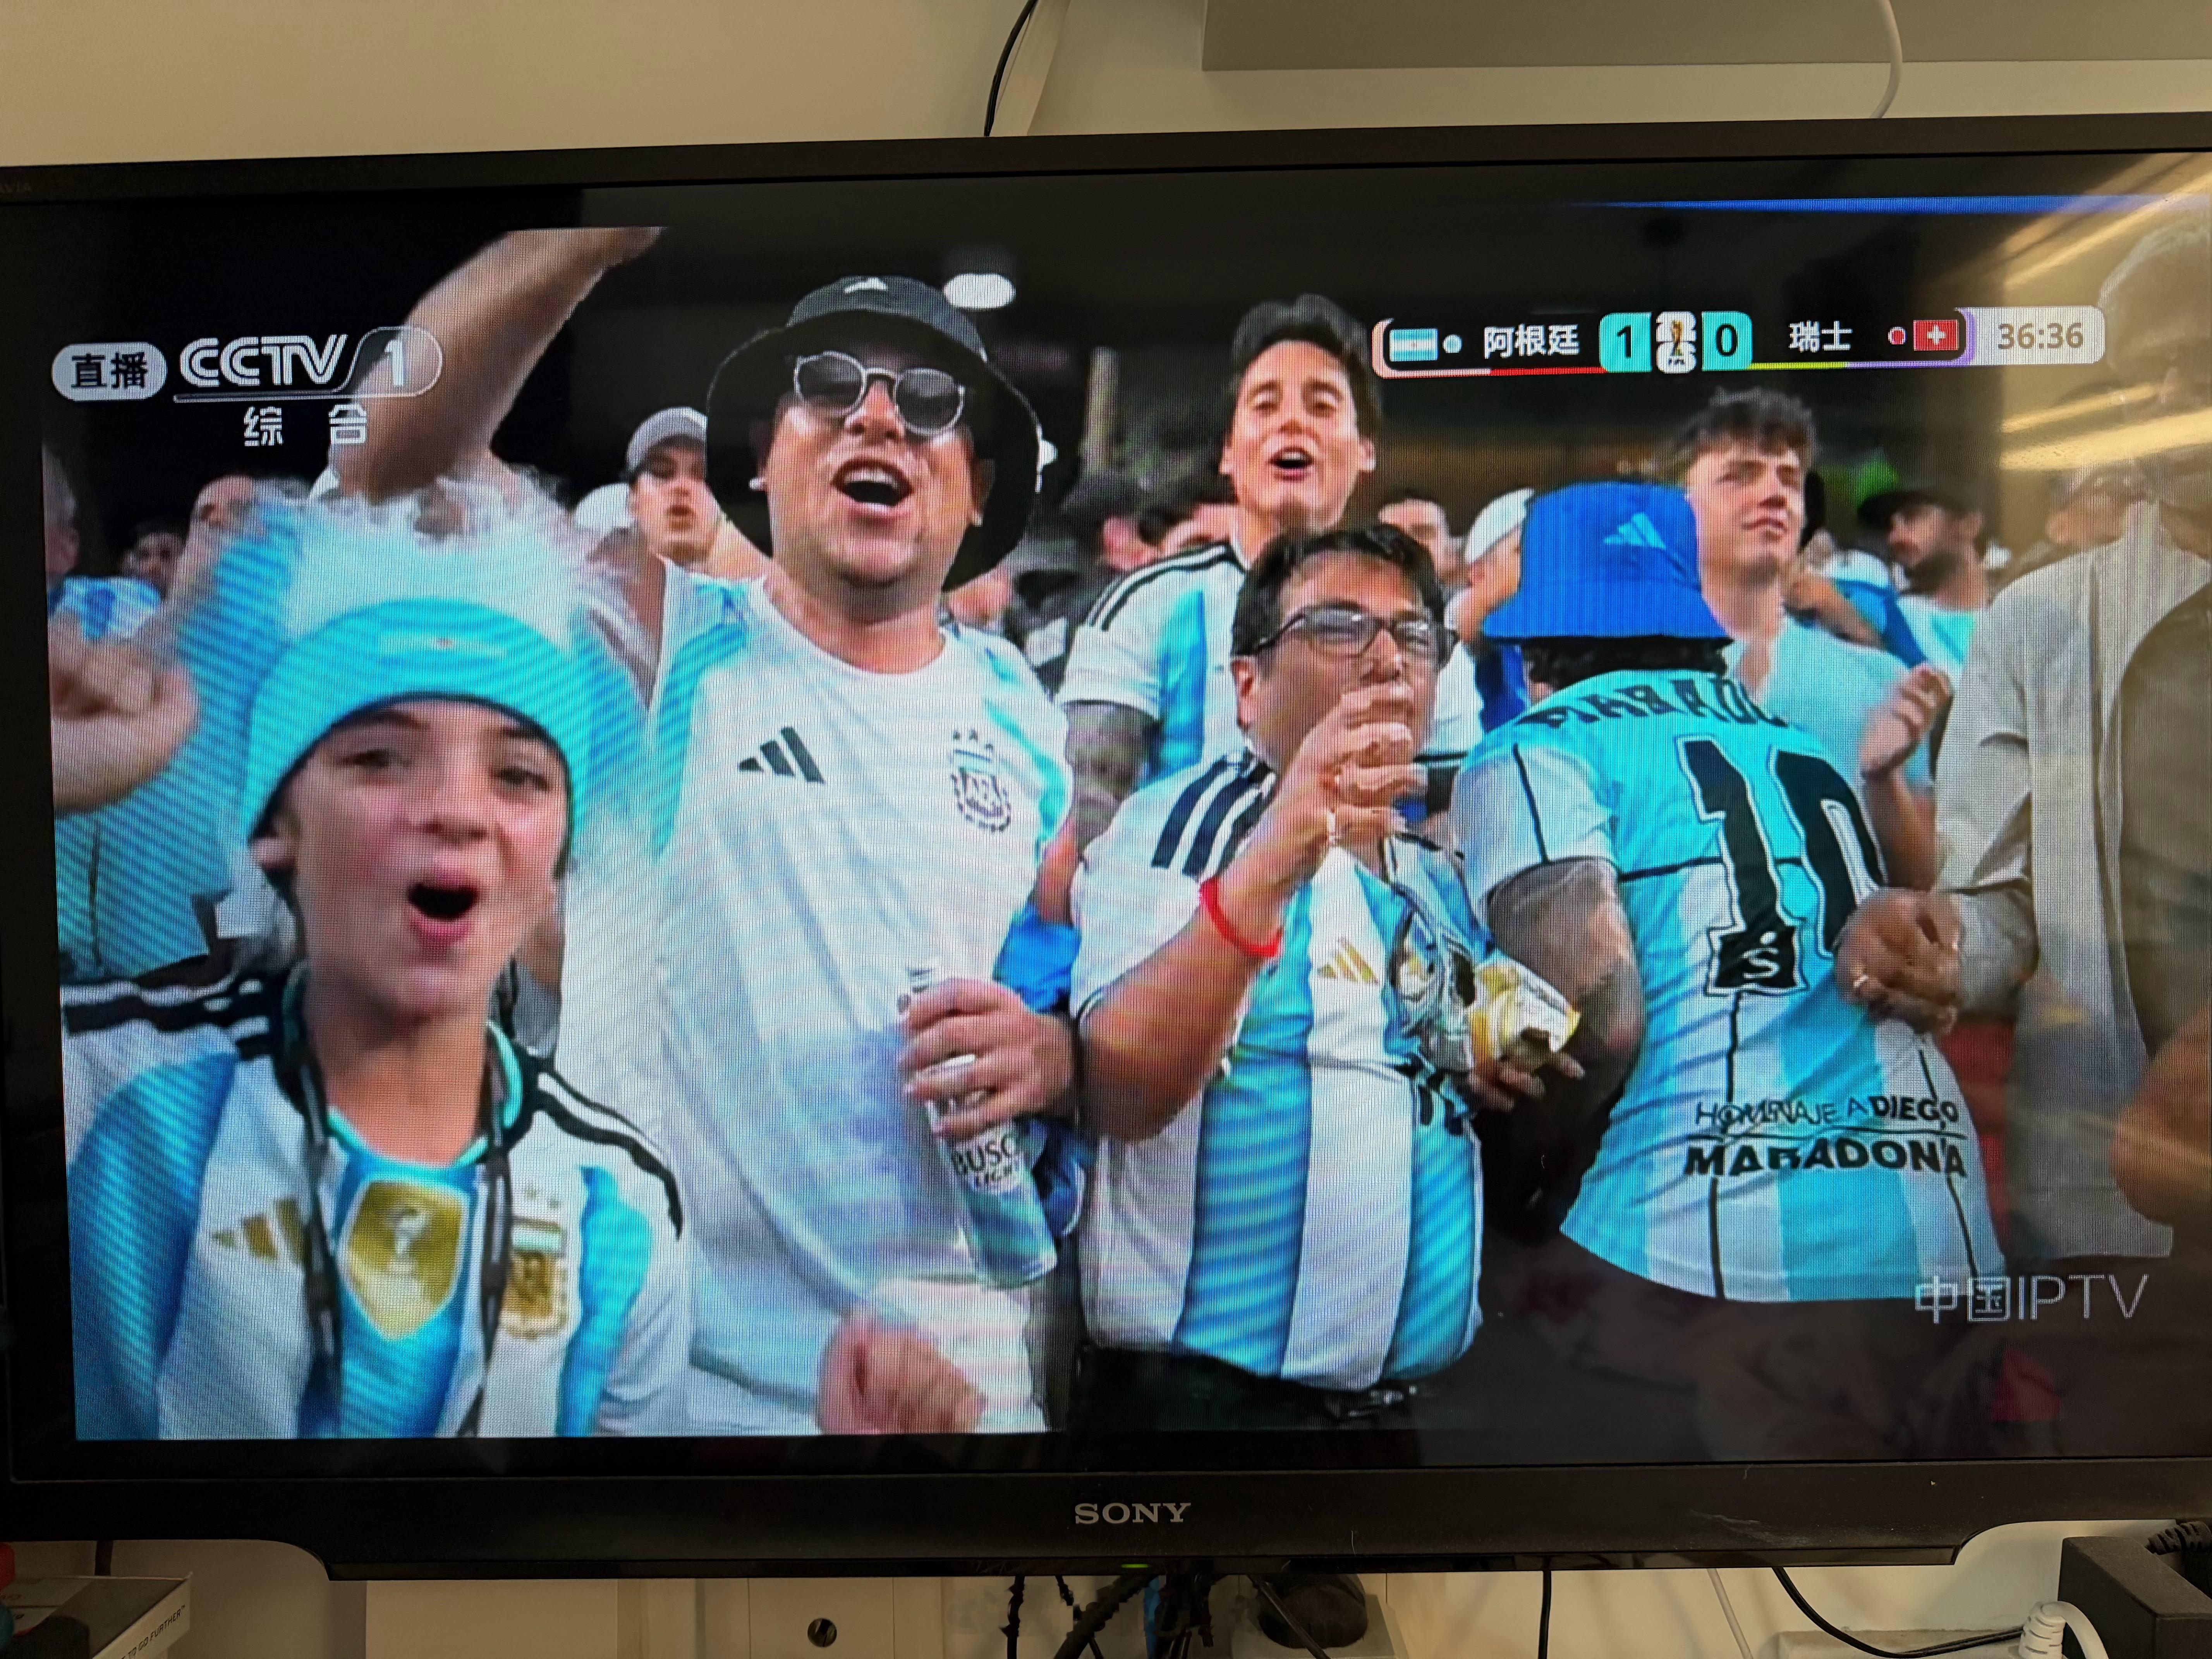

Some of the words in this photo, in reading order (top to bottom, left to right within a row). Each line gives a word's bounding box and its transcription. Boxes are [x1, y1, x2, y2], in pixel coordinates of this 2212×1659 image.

[1484, 324, 1579, 359] 阿根廷
[1617, 325, 1632, 358] 1
[1716, 324, 1738, 356] 0
[1788, 320, 1853, 353] 瑞士
[1998, 322, 2083, 350] 36:36
[71, 351, 148, 390] 直播
[180, 334, 348, 387] CCTV
[384, 339, 405, 386] 1
[243, 404, 368, 447] 综合
[1675, 735, 1888, 996] 10
[1848, 1096, 1865, 1117] A
[1869, 1095, 1958, 1123] DIEGO
[1685, 1137, 1968, 1177] MARADONA
[1915, 1273, 2149, 1323] 中国IPTV
[1075, 1502, 1192, 1524] SONY
[138, 1637, 148, 1651] GO
